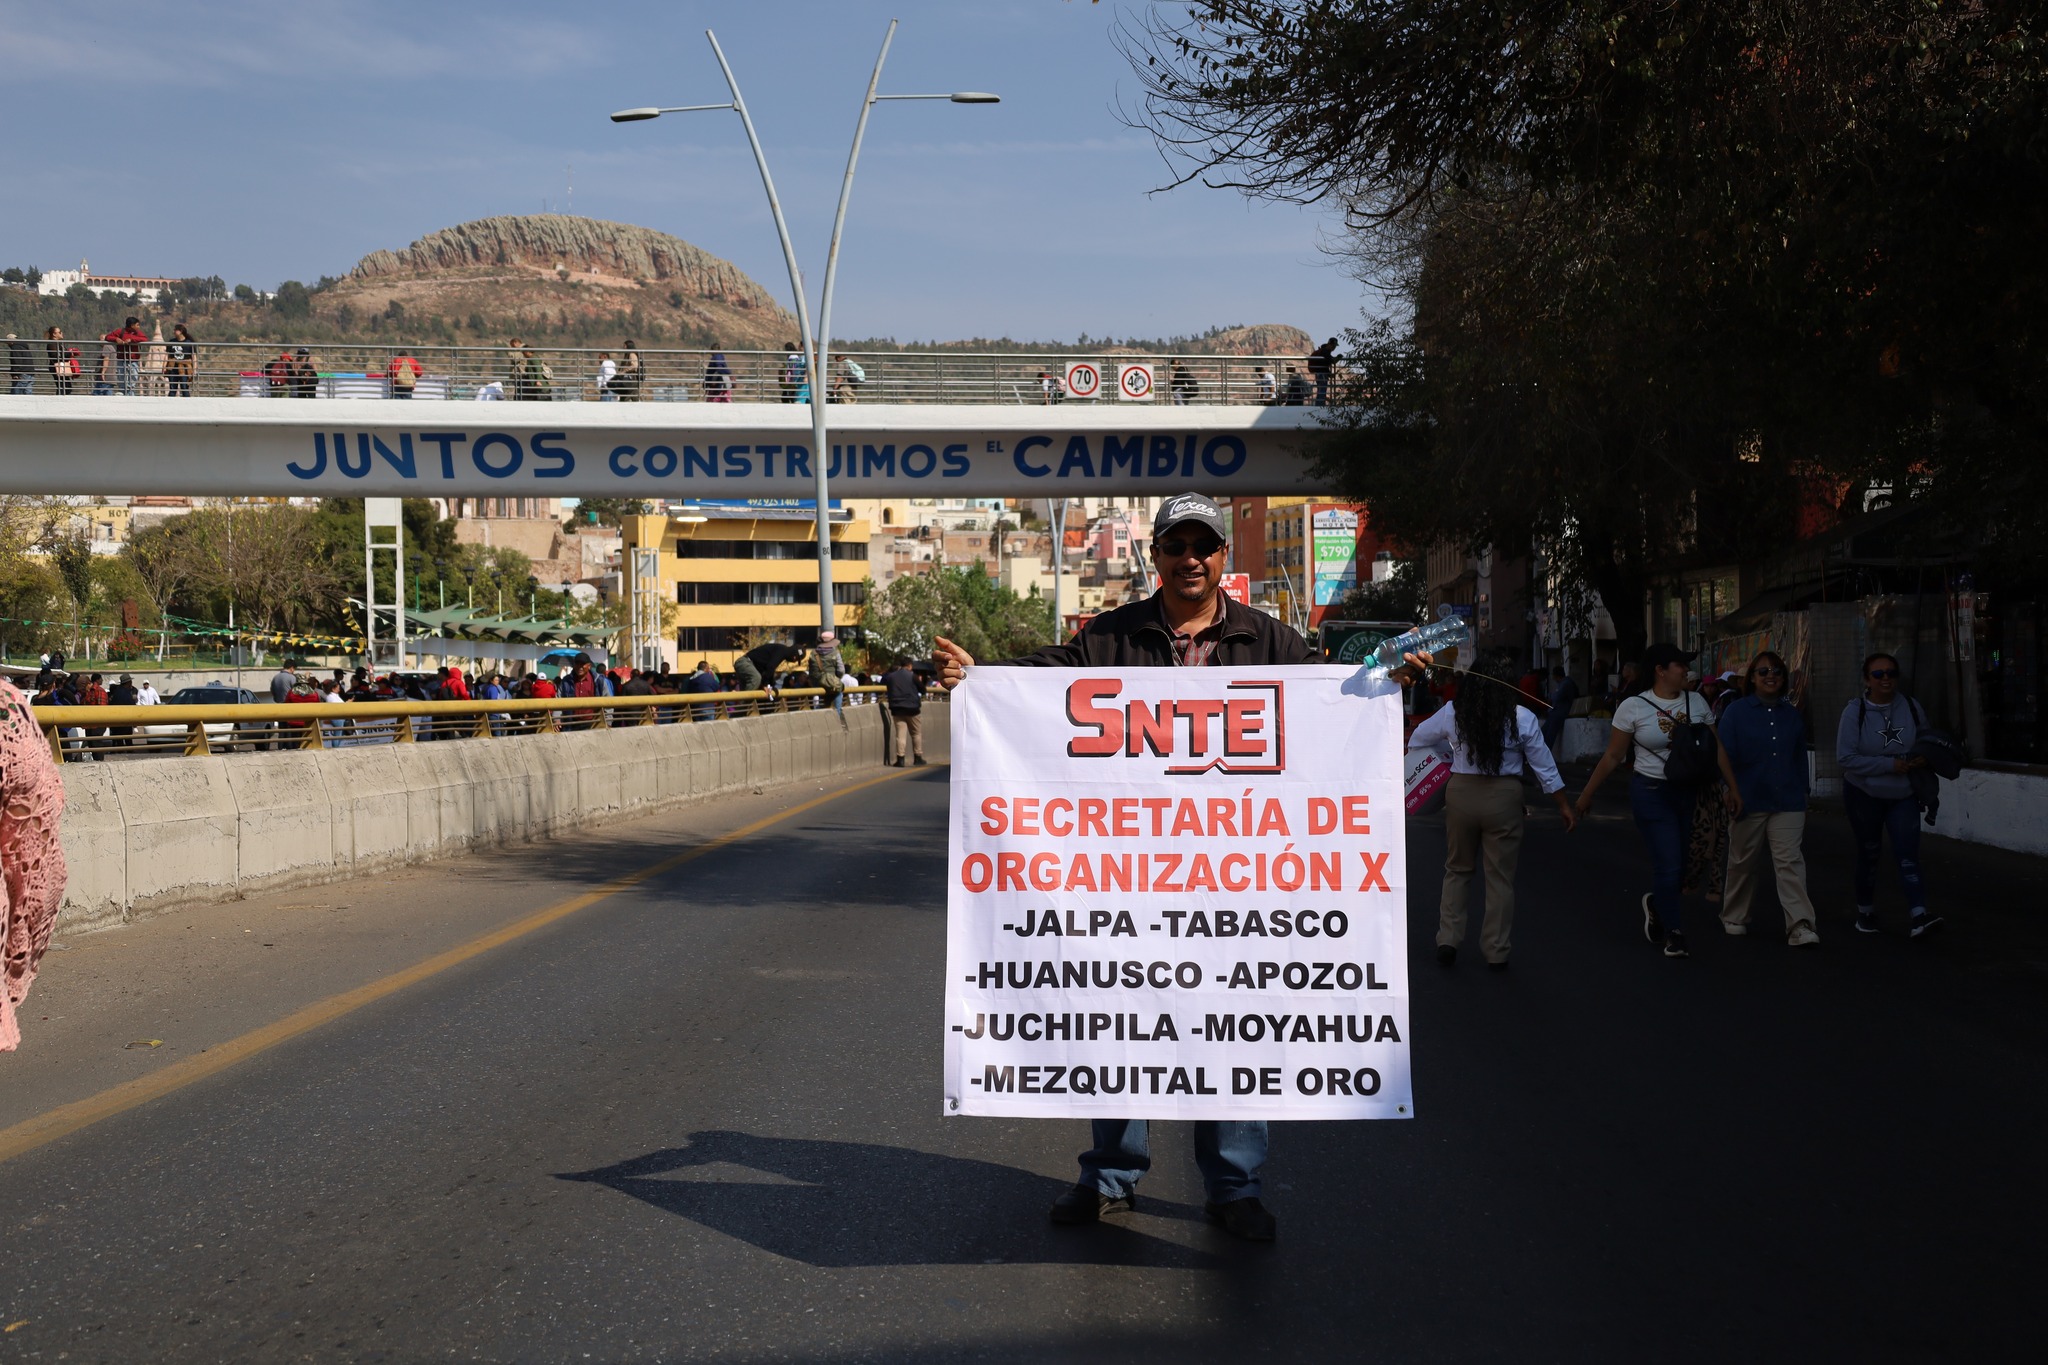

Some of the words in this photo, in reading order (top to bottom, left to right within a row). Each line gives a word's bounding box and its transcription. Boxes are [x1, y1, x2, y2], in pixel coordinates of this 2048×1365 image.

[1076, 370, 1092, 385] 70
[286, 432, 575, 479] JUNTOS
[608, 444, 971, 479] CONSTRUIMOS
[986, 441, 1004, 453] EL
[1013, 434, 1247, 478] CAMBIO
[1169, 495, 1216, 516] Texas
[1320, 546, 1350, 558] $790
[1066, 678, 1267, 758] SNTE
[980, 788, 1291, 837] SECRETARÍA
[1307, 795, 1371, 836] DE
[961, 843, 1342, 893] ORGANIZACIÓN
[1358, 852, 1391, 893] X
[1003, 910, 1138, 938] -JALPA
[1150, 910, 1349, 938] -TABASCO
[965, 961, 1203, 990] -HUANUSCO
[1215, 962, 1388, 990] -APOZOL
[952, 1013, 1179, 1042] -JUCHIPILA
[1191, 1013, 1401, 1043] -MOYAHUA
[970, 1065, 1218, 1097] -MEZQUITAL
[1231, 1067, 1282, 1096] DE
[1295, 1067, 1382, 1097] ORO
